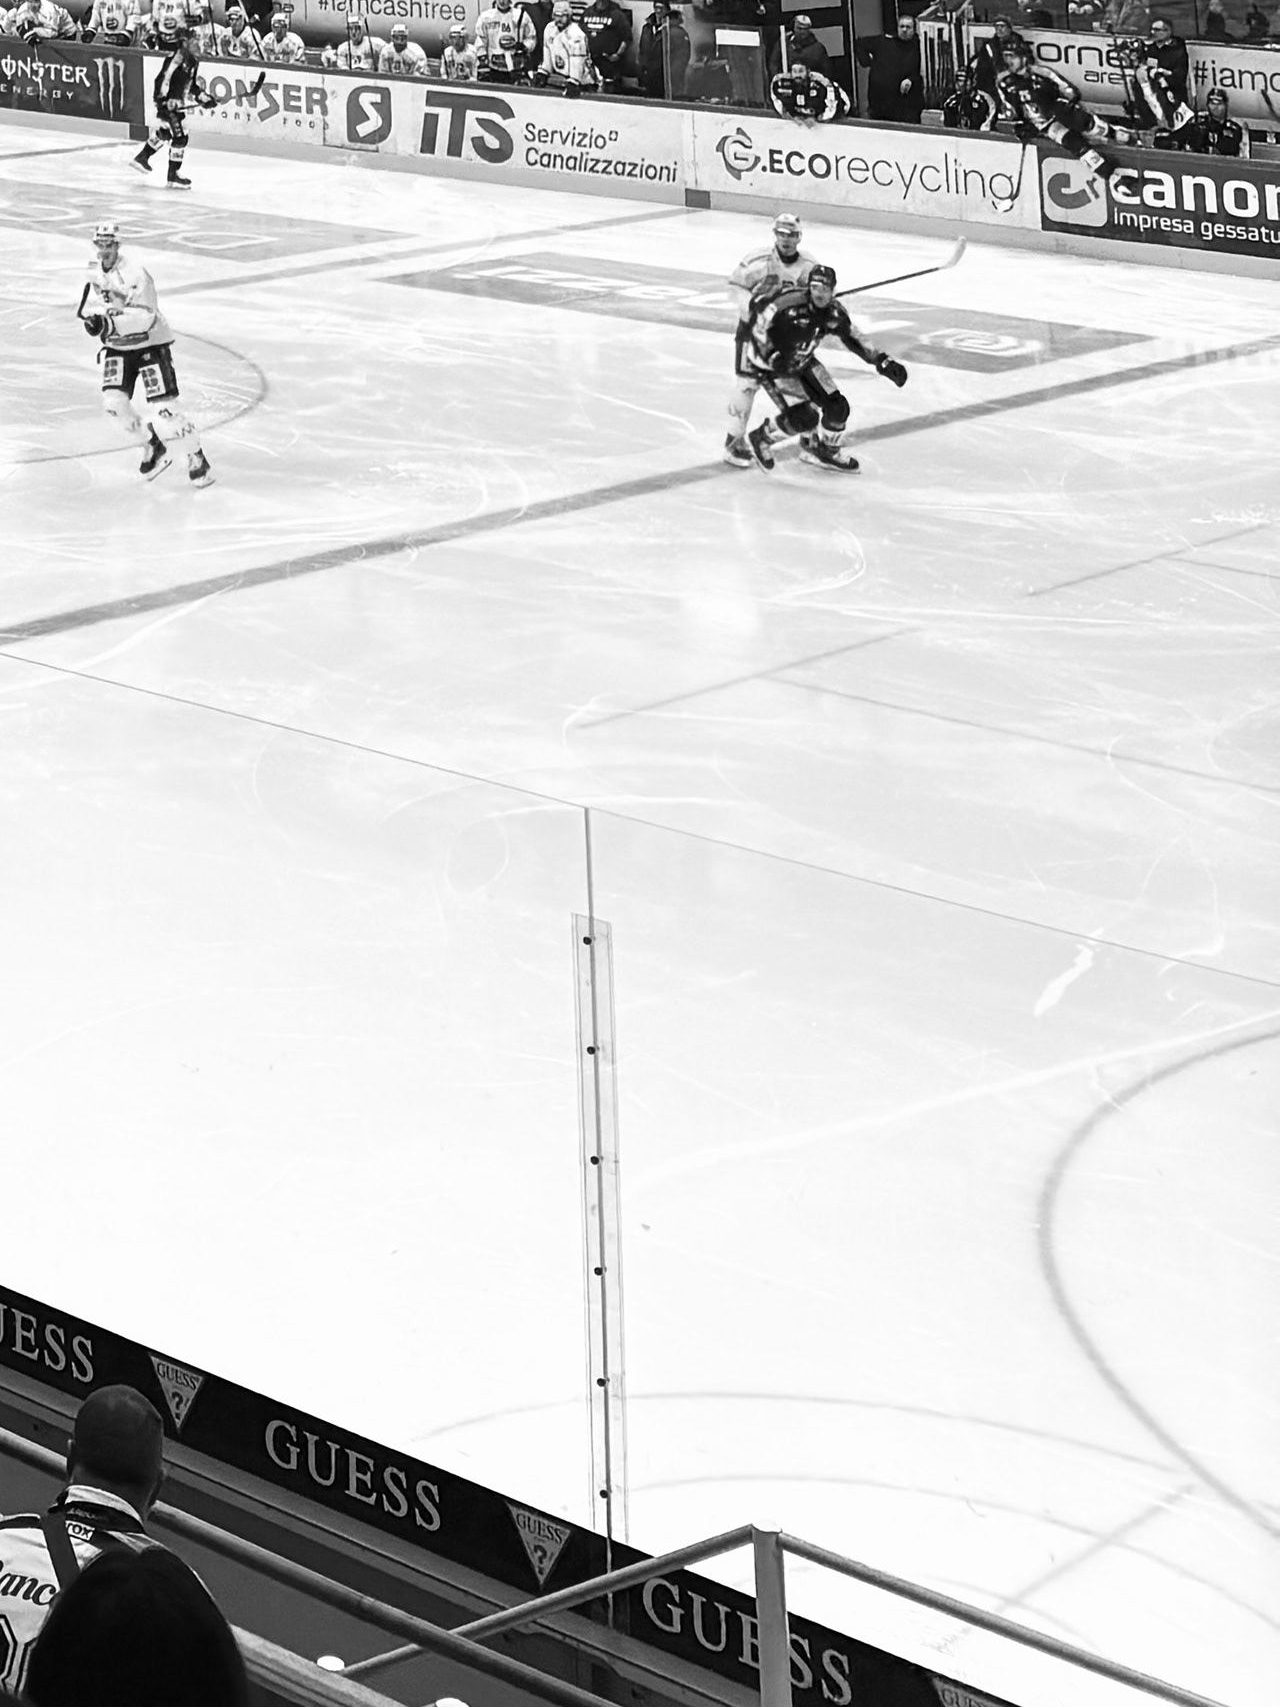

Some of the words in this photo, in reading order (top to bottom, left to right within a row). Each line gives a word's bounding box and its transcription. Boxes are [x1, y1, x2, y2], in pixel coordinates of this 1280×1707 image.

[0, 83, 75, 100] ENERGY
[524, 122, 607, 150] Servizio
[525, 147, 678, 183] Canalizzazioni
[1114, 207, 1195, 234] impresa
[155, 1361, 198, 1390] GUESS
[265, 1419, 441, 1532] GUESS
[515, 1512, 564, 1544] GUESS
